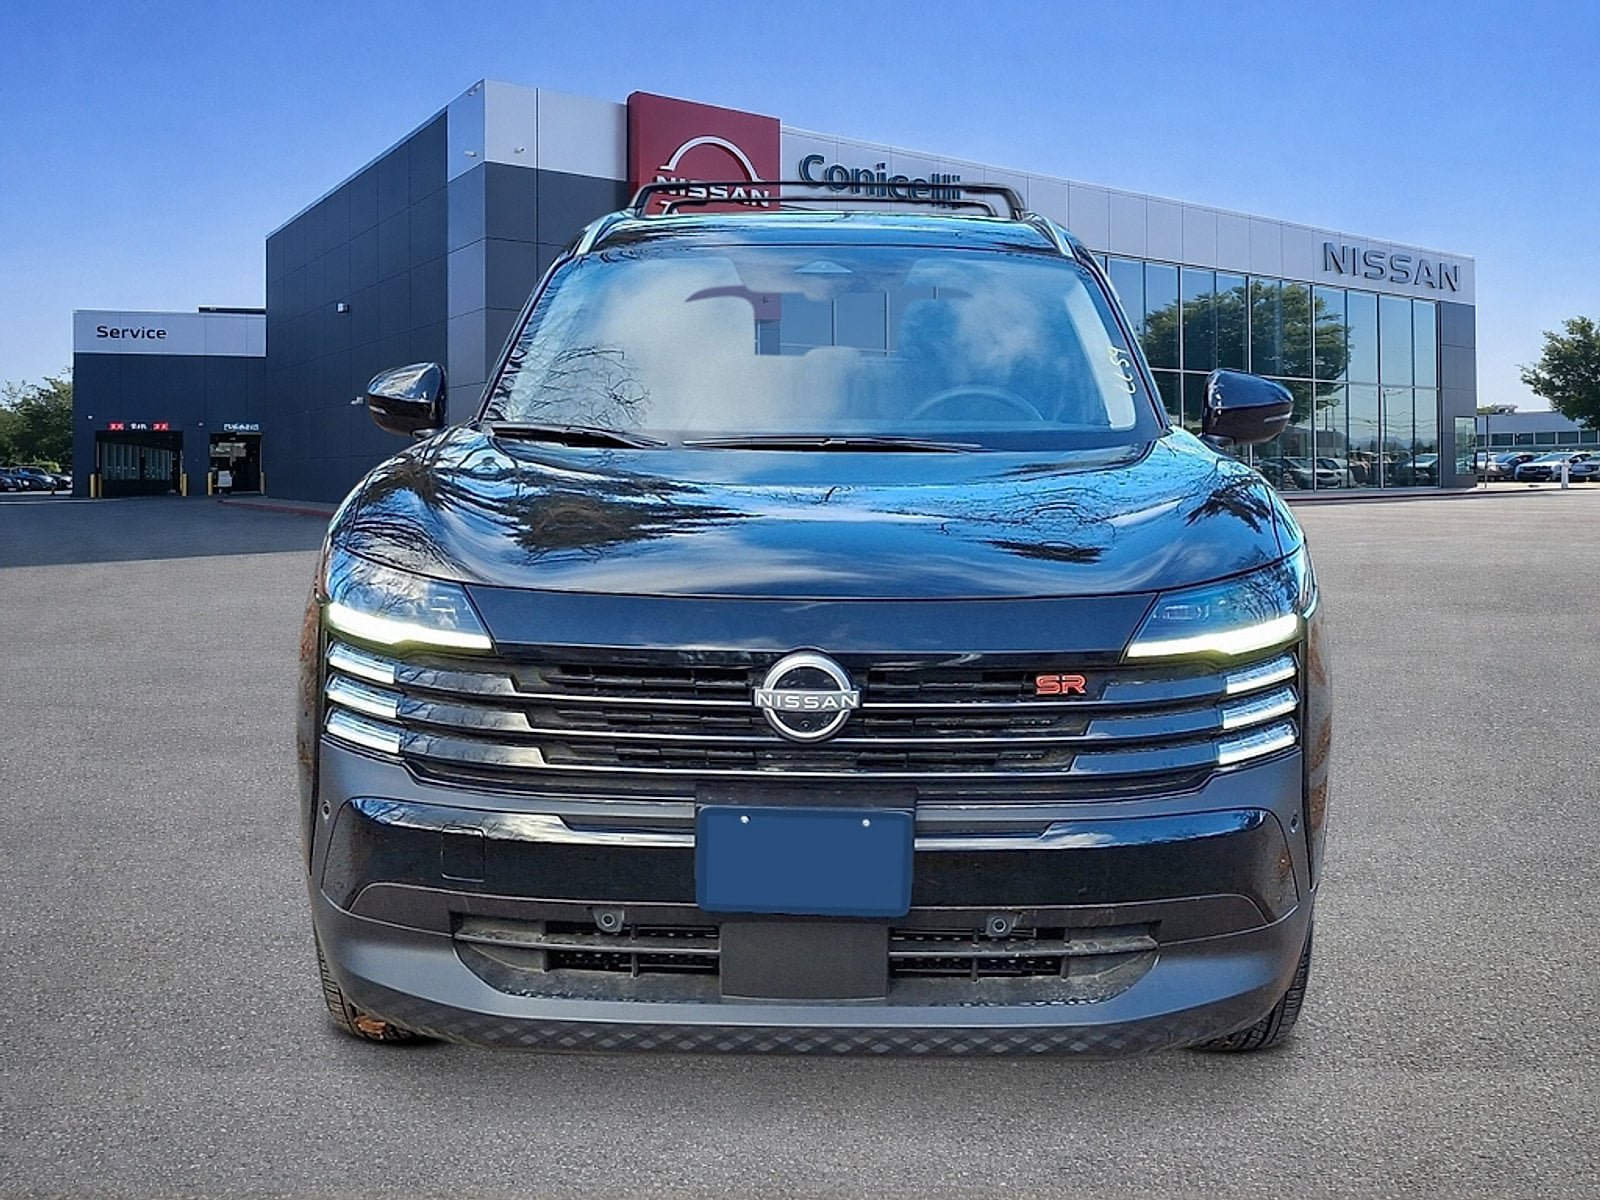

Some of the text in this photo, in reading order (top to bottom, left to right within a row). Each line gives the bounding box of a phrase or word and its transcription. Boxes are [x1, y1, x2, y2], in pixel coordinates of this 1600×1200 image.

[799, 154, 961, 209] Conicelli
[1323, 242, 1461, 292] NISSAN
[96, 325, 167, 339] Service
[1036, 675, 1086, 694] SR
[757, 692, 858, 709] NISSAN
